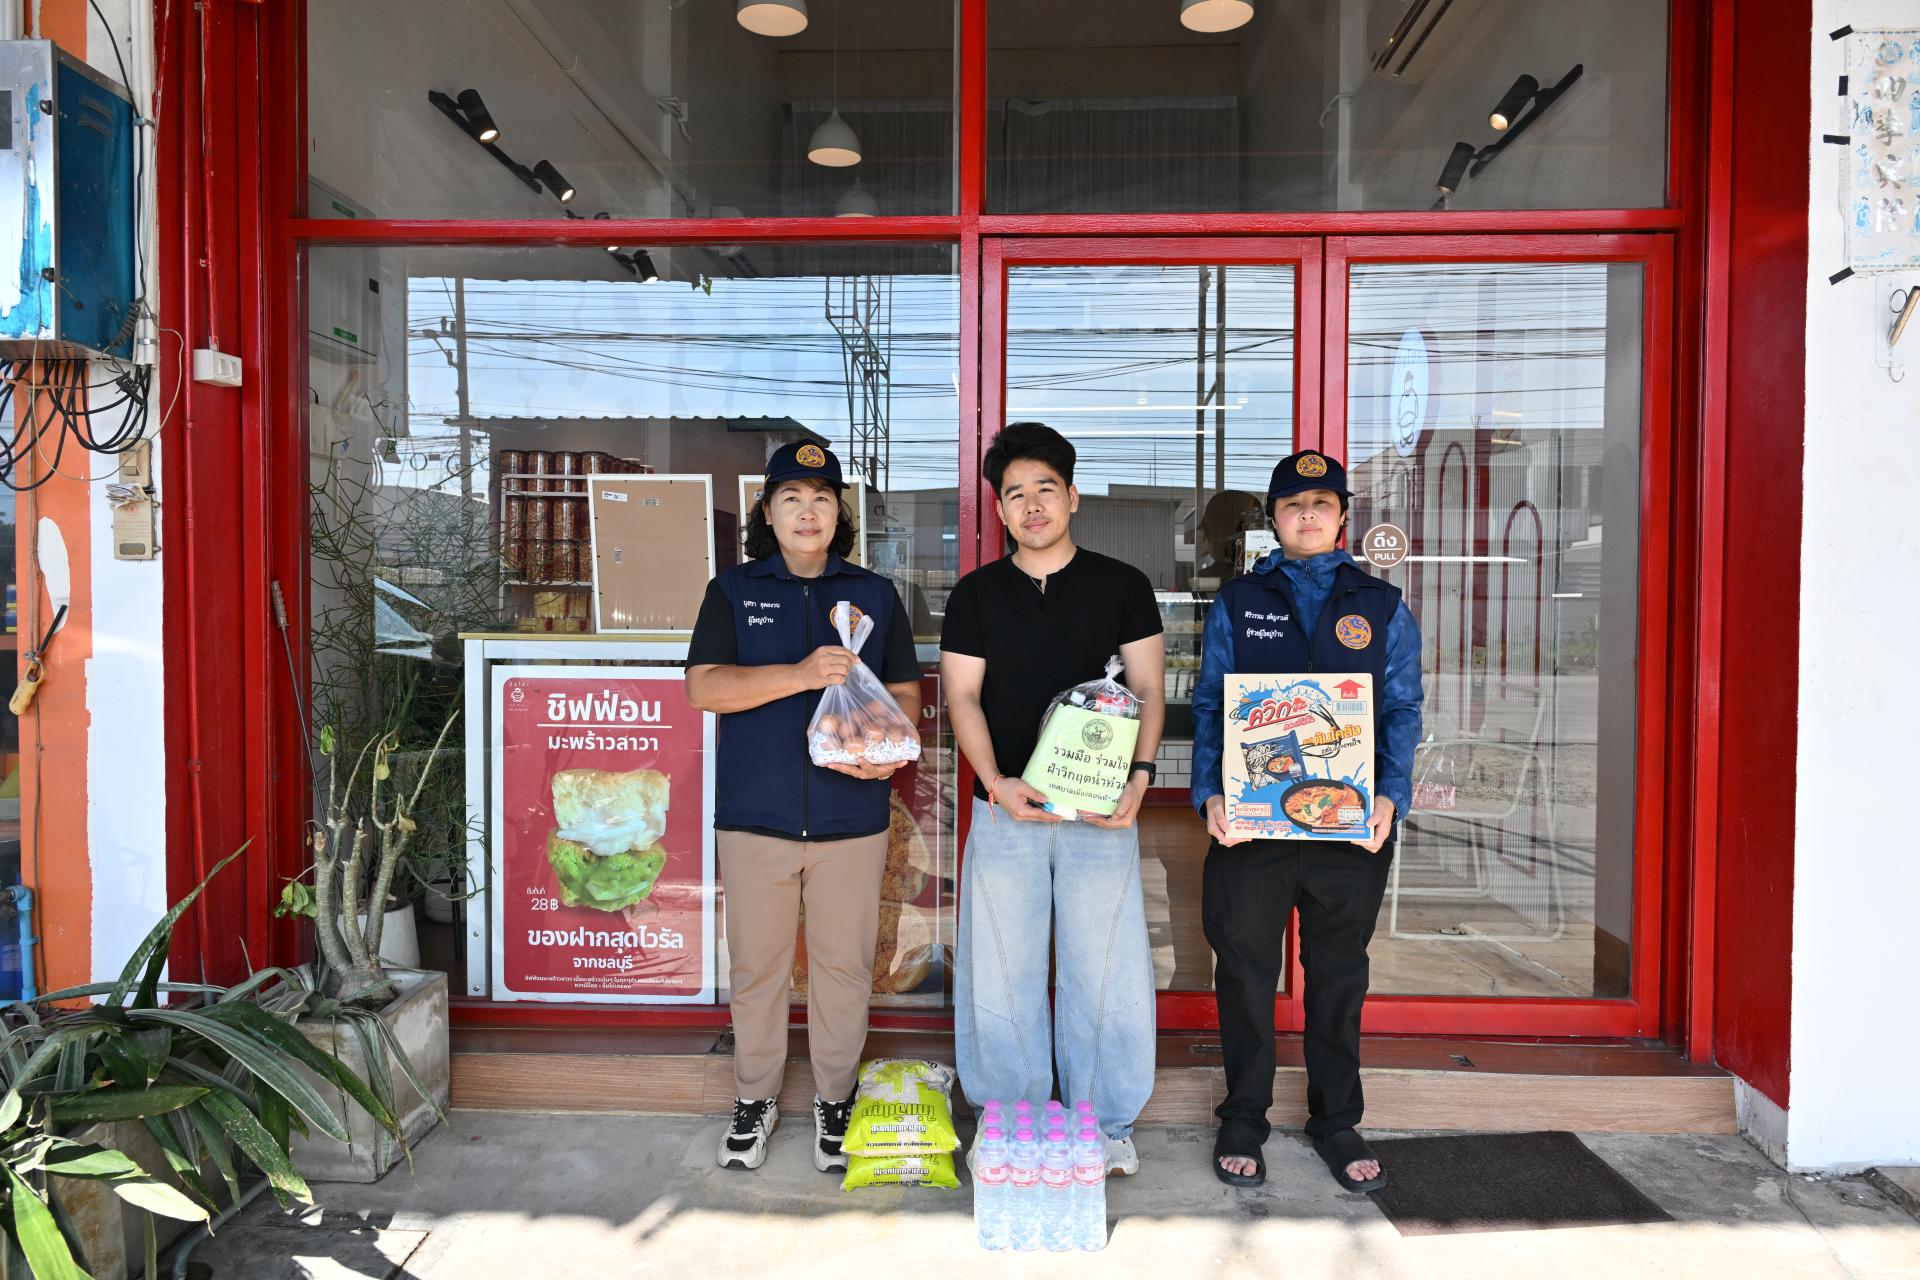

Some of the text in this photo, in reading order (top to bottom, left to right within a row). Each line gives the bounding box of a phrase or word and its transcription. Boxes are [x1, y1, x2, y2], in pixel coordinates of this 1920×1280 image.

[1373, 531, 1397, 548] ดึง
[1374, 553, 1397, 561] PULL
[547, 689, 661, 722] ชิฟฟ่อน
[1248, 699, 1292, 727] ควิก
[548, 730, 659, 751] มะพร้าวลาวา
[1096, 753, 1129, 771] ร่วมใจ
[528, 925, 684, 953] ของฝากสุดไวรัล
[573, 955, 634, 974] จากชลบุรี
